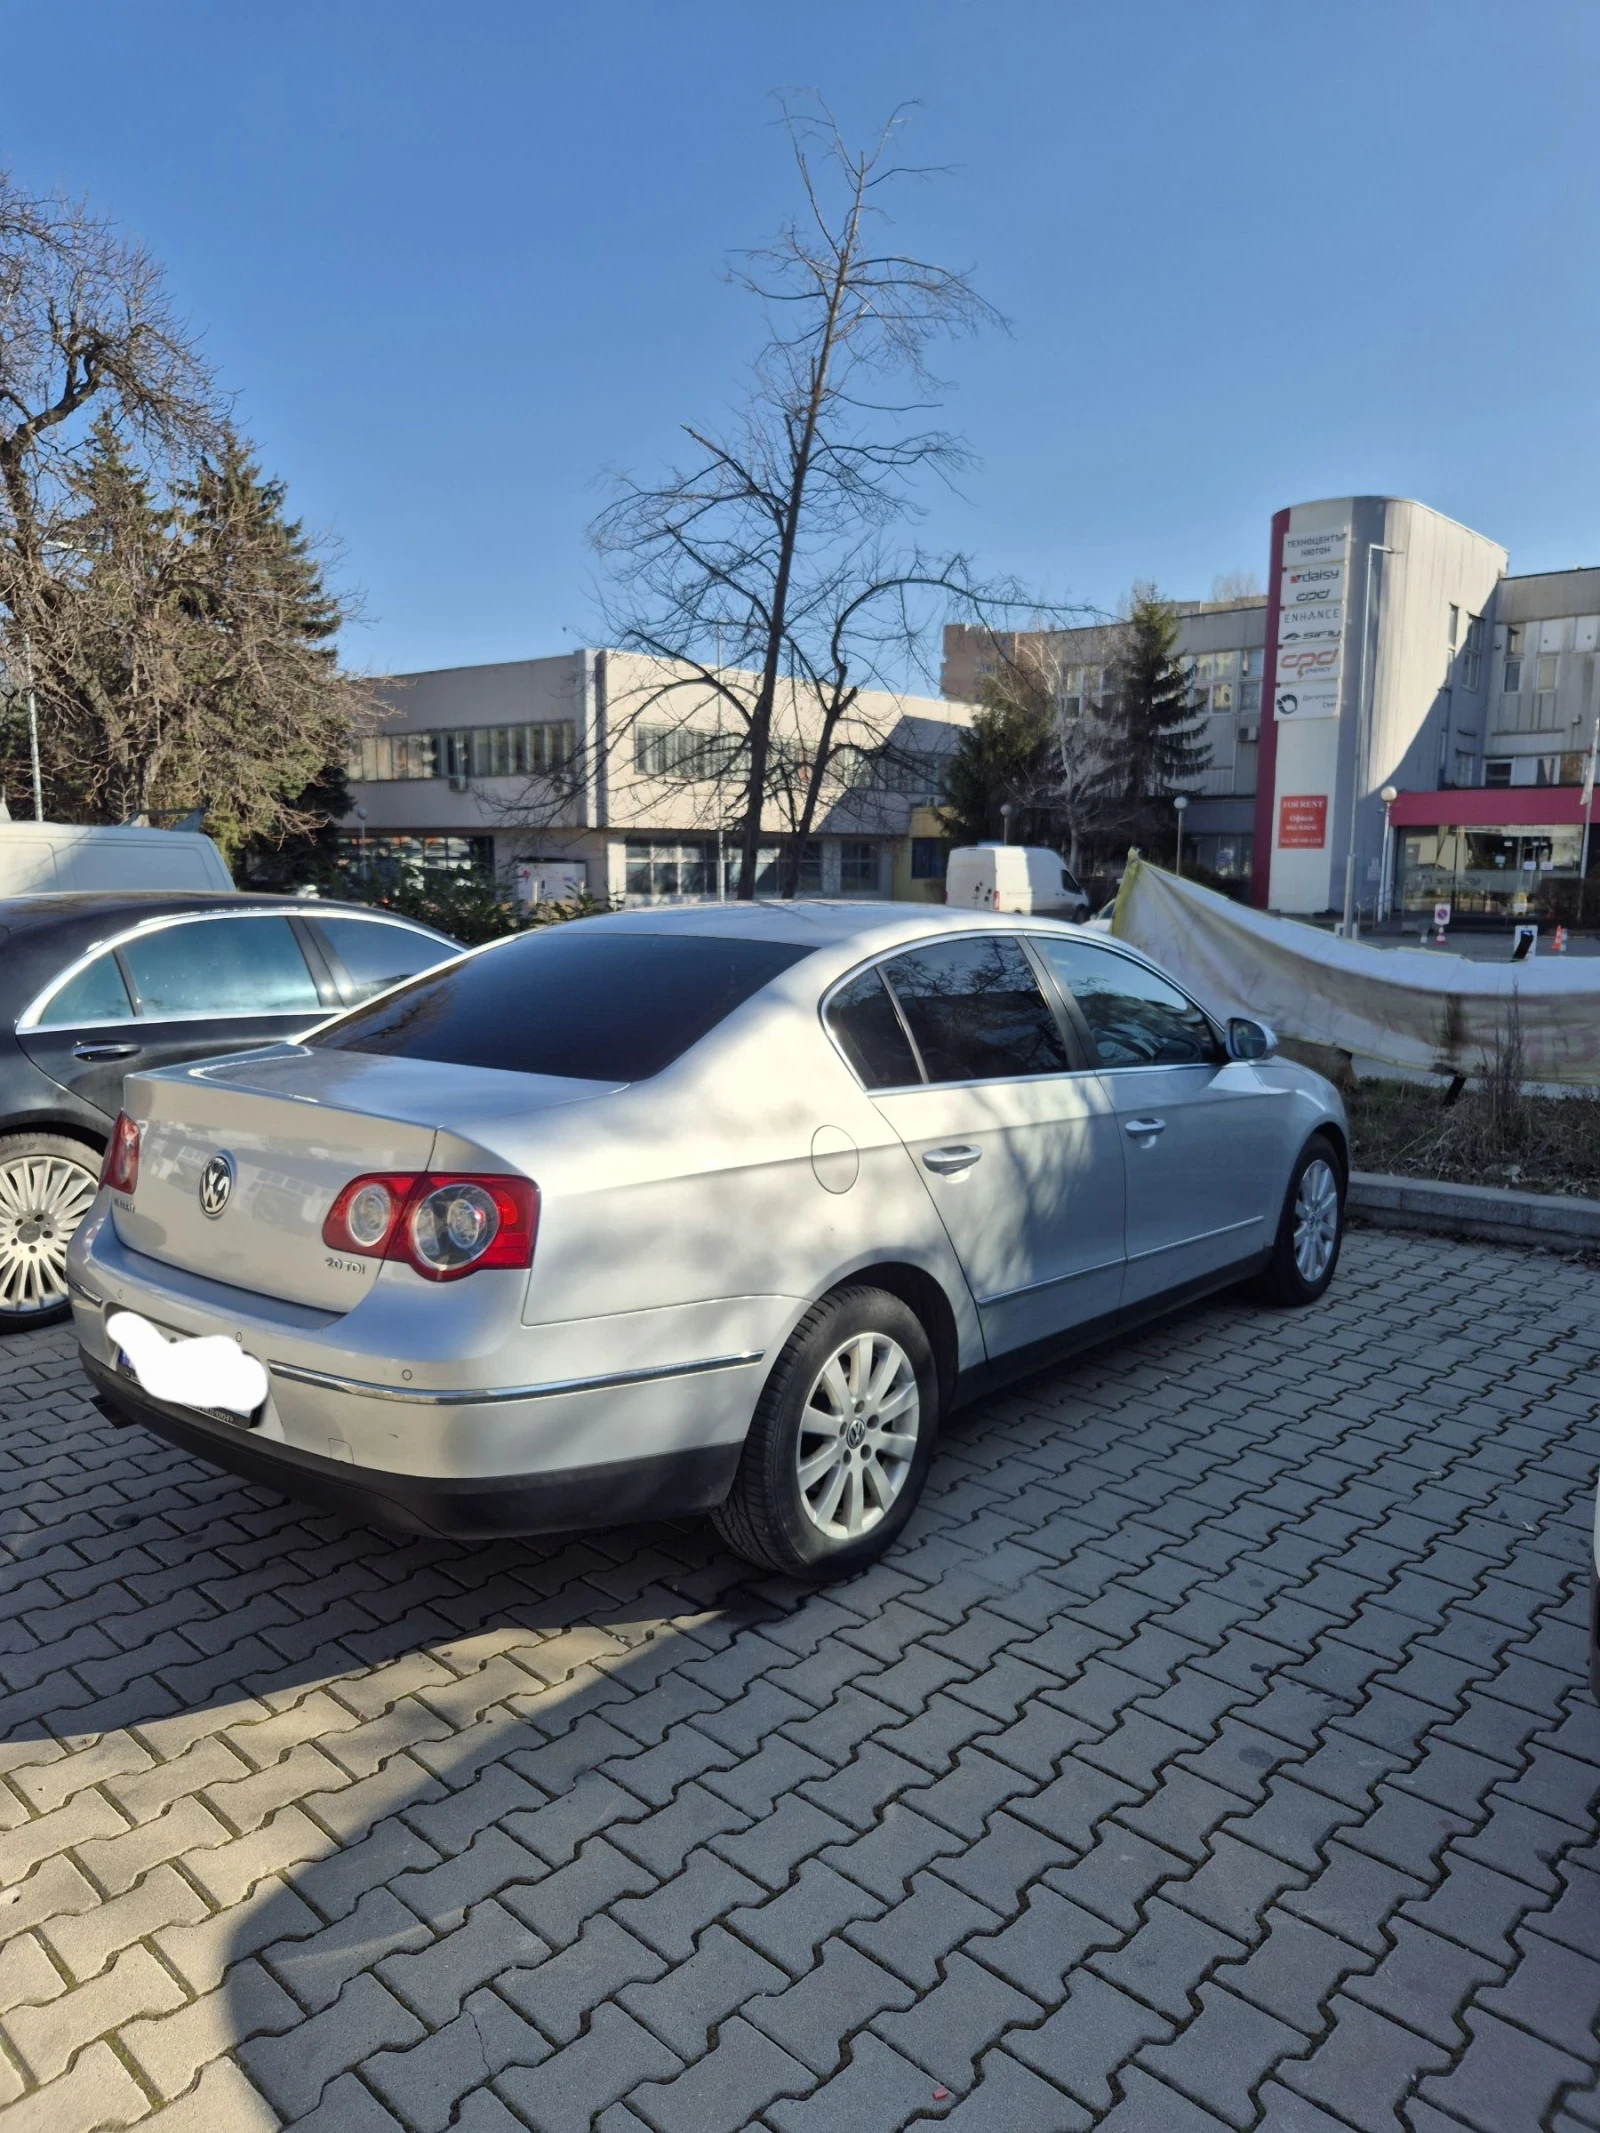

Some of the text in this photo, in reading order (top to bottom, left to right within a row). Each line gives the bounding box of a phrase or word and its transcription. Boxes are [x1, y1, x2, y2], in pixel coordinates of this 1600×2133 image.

[1287, 533, 1347, 548] ТЕХНОЦЕНТЪР
[1301, 547, 1331, 557] НЮТОН
[1284, 608, 1340, 624] ENHANCE
[1283, 800, 1324, 808] FOR RENT
[343, 1261, 365, 1275] TDI
